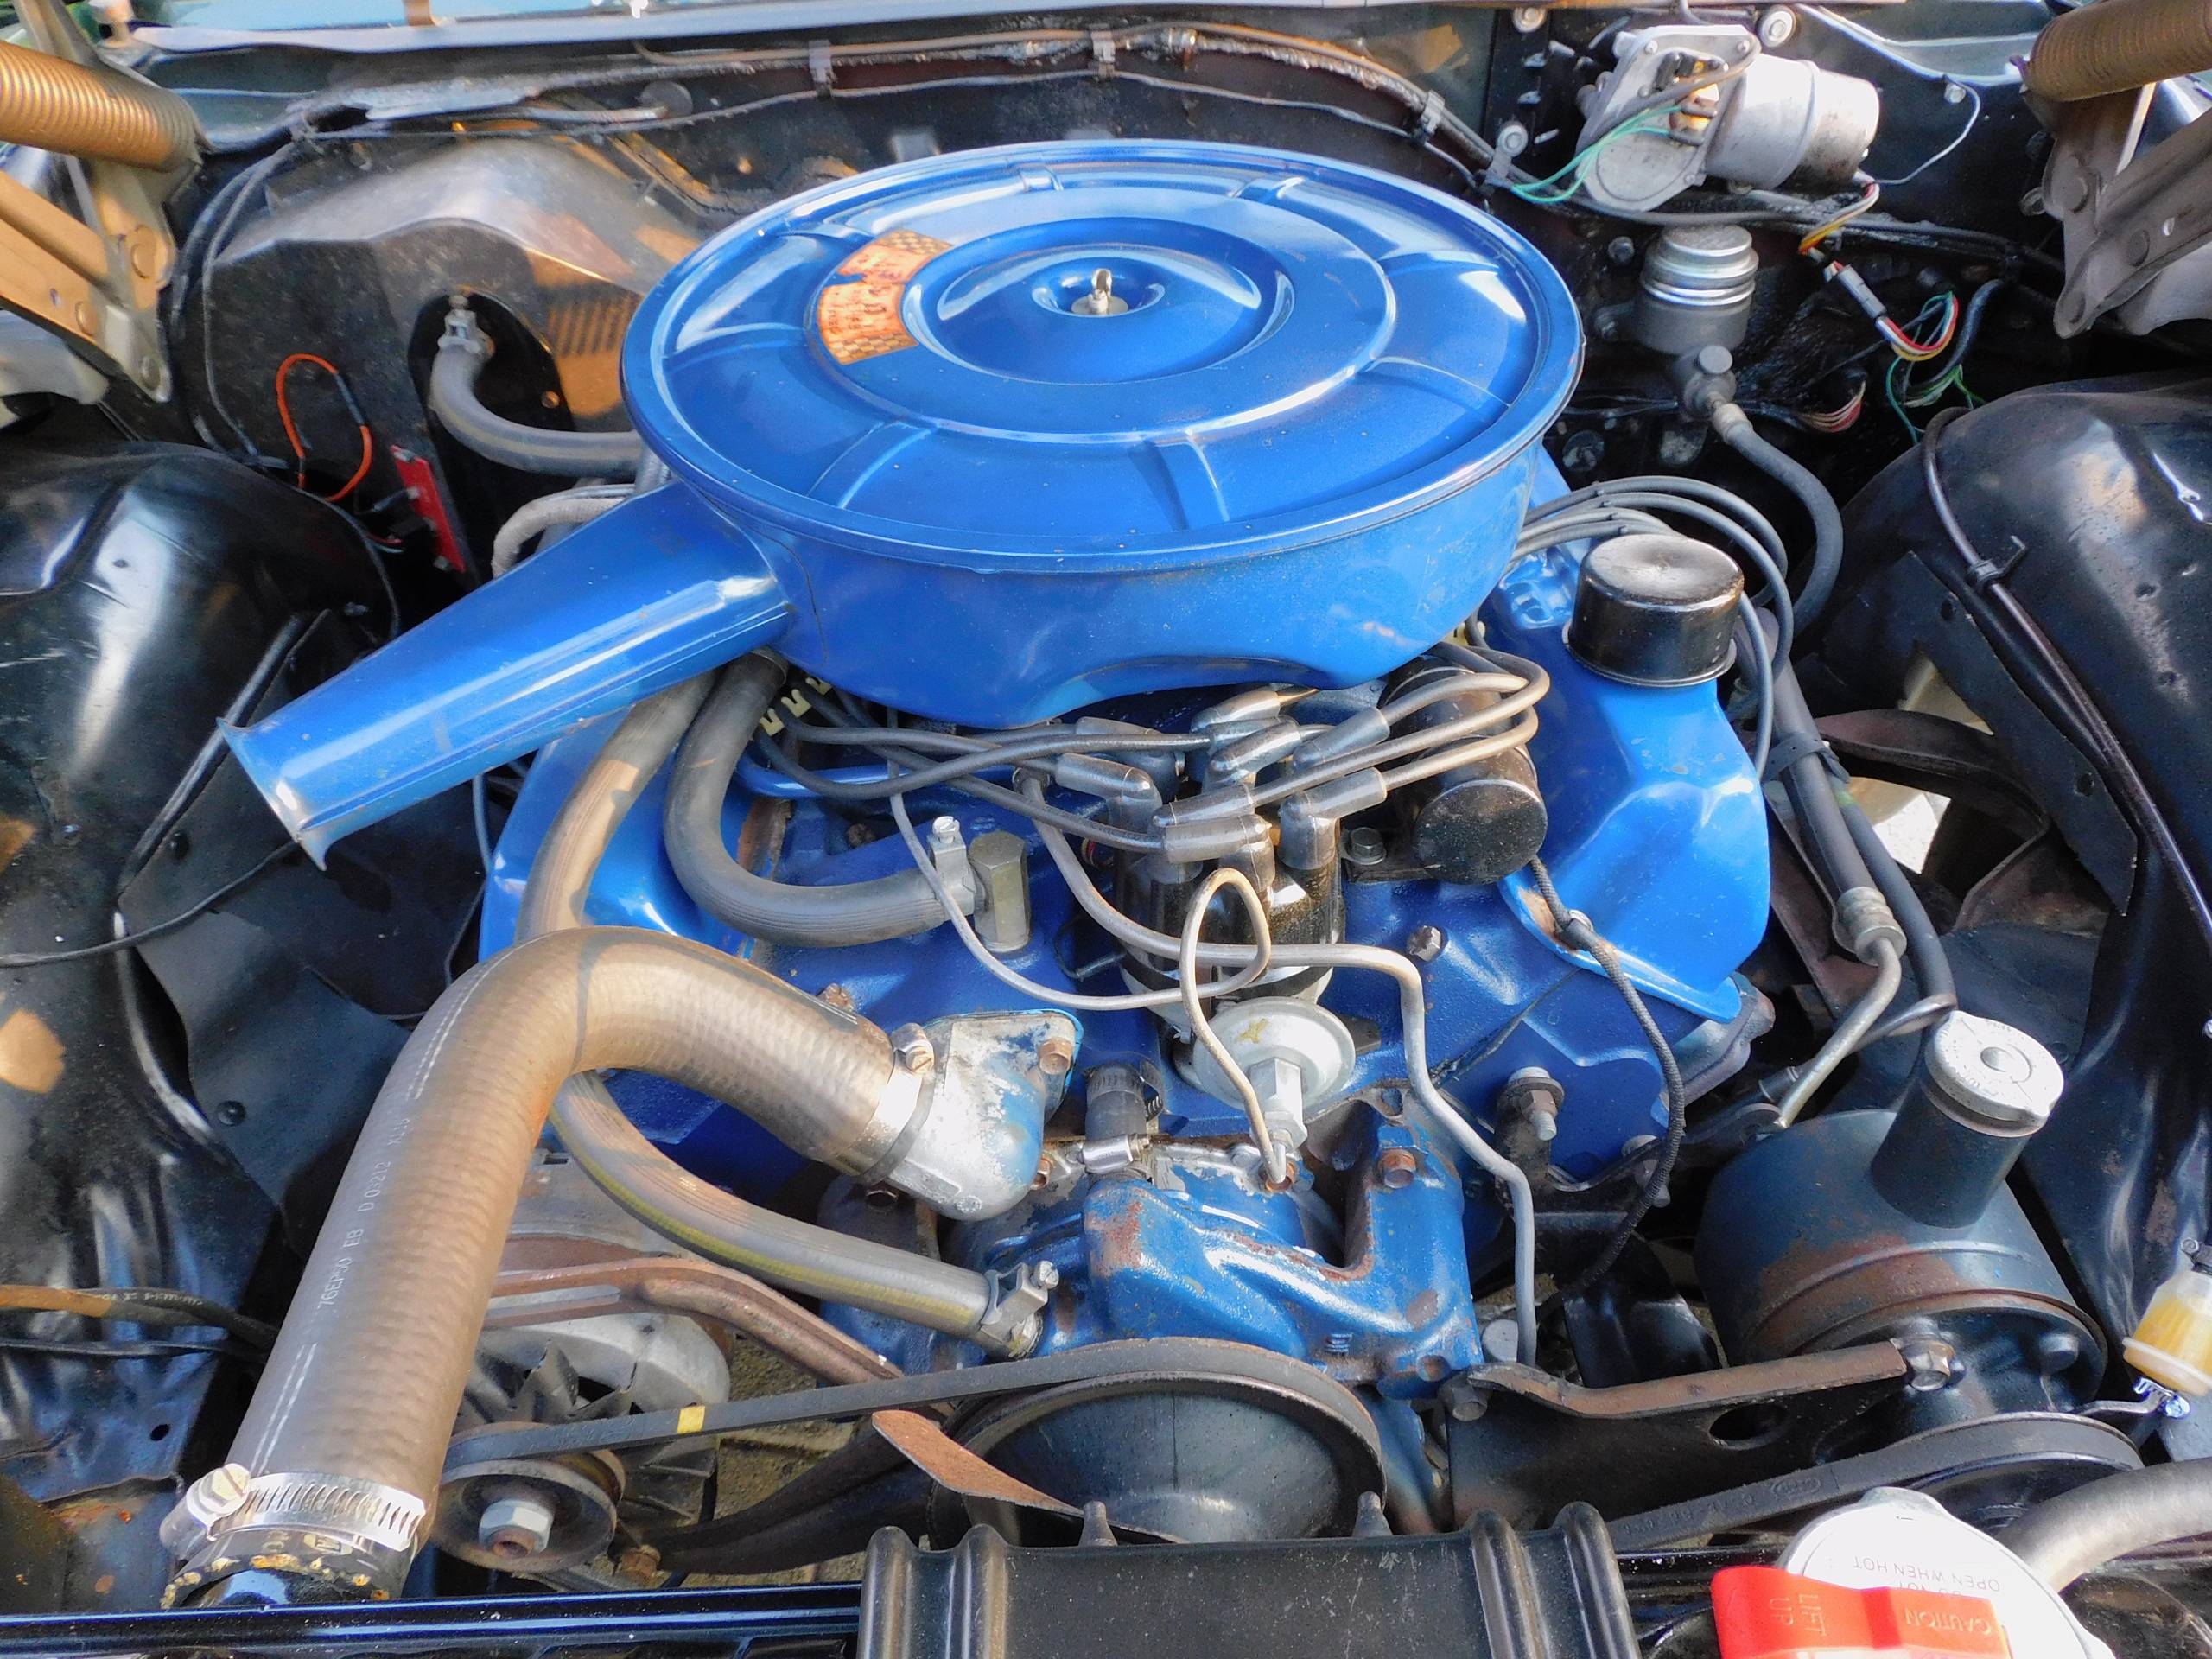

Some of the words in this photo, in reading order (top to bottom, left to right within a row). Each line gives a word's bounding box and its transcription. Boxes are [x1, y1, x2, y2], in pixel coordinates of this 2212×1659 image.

[1853, 1556, 1887, 1572] HOT
[1894, 1563, 1942, 1584] WHEN
[1951, 1574, 2000, 1592] OPEN
[1770, 1598, 1795, 1625] UP
[1799, 1594, 1827, 1637] LIFT
[1904, 1608, 1992, 1635] CAUTION
